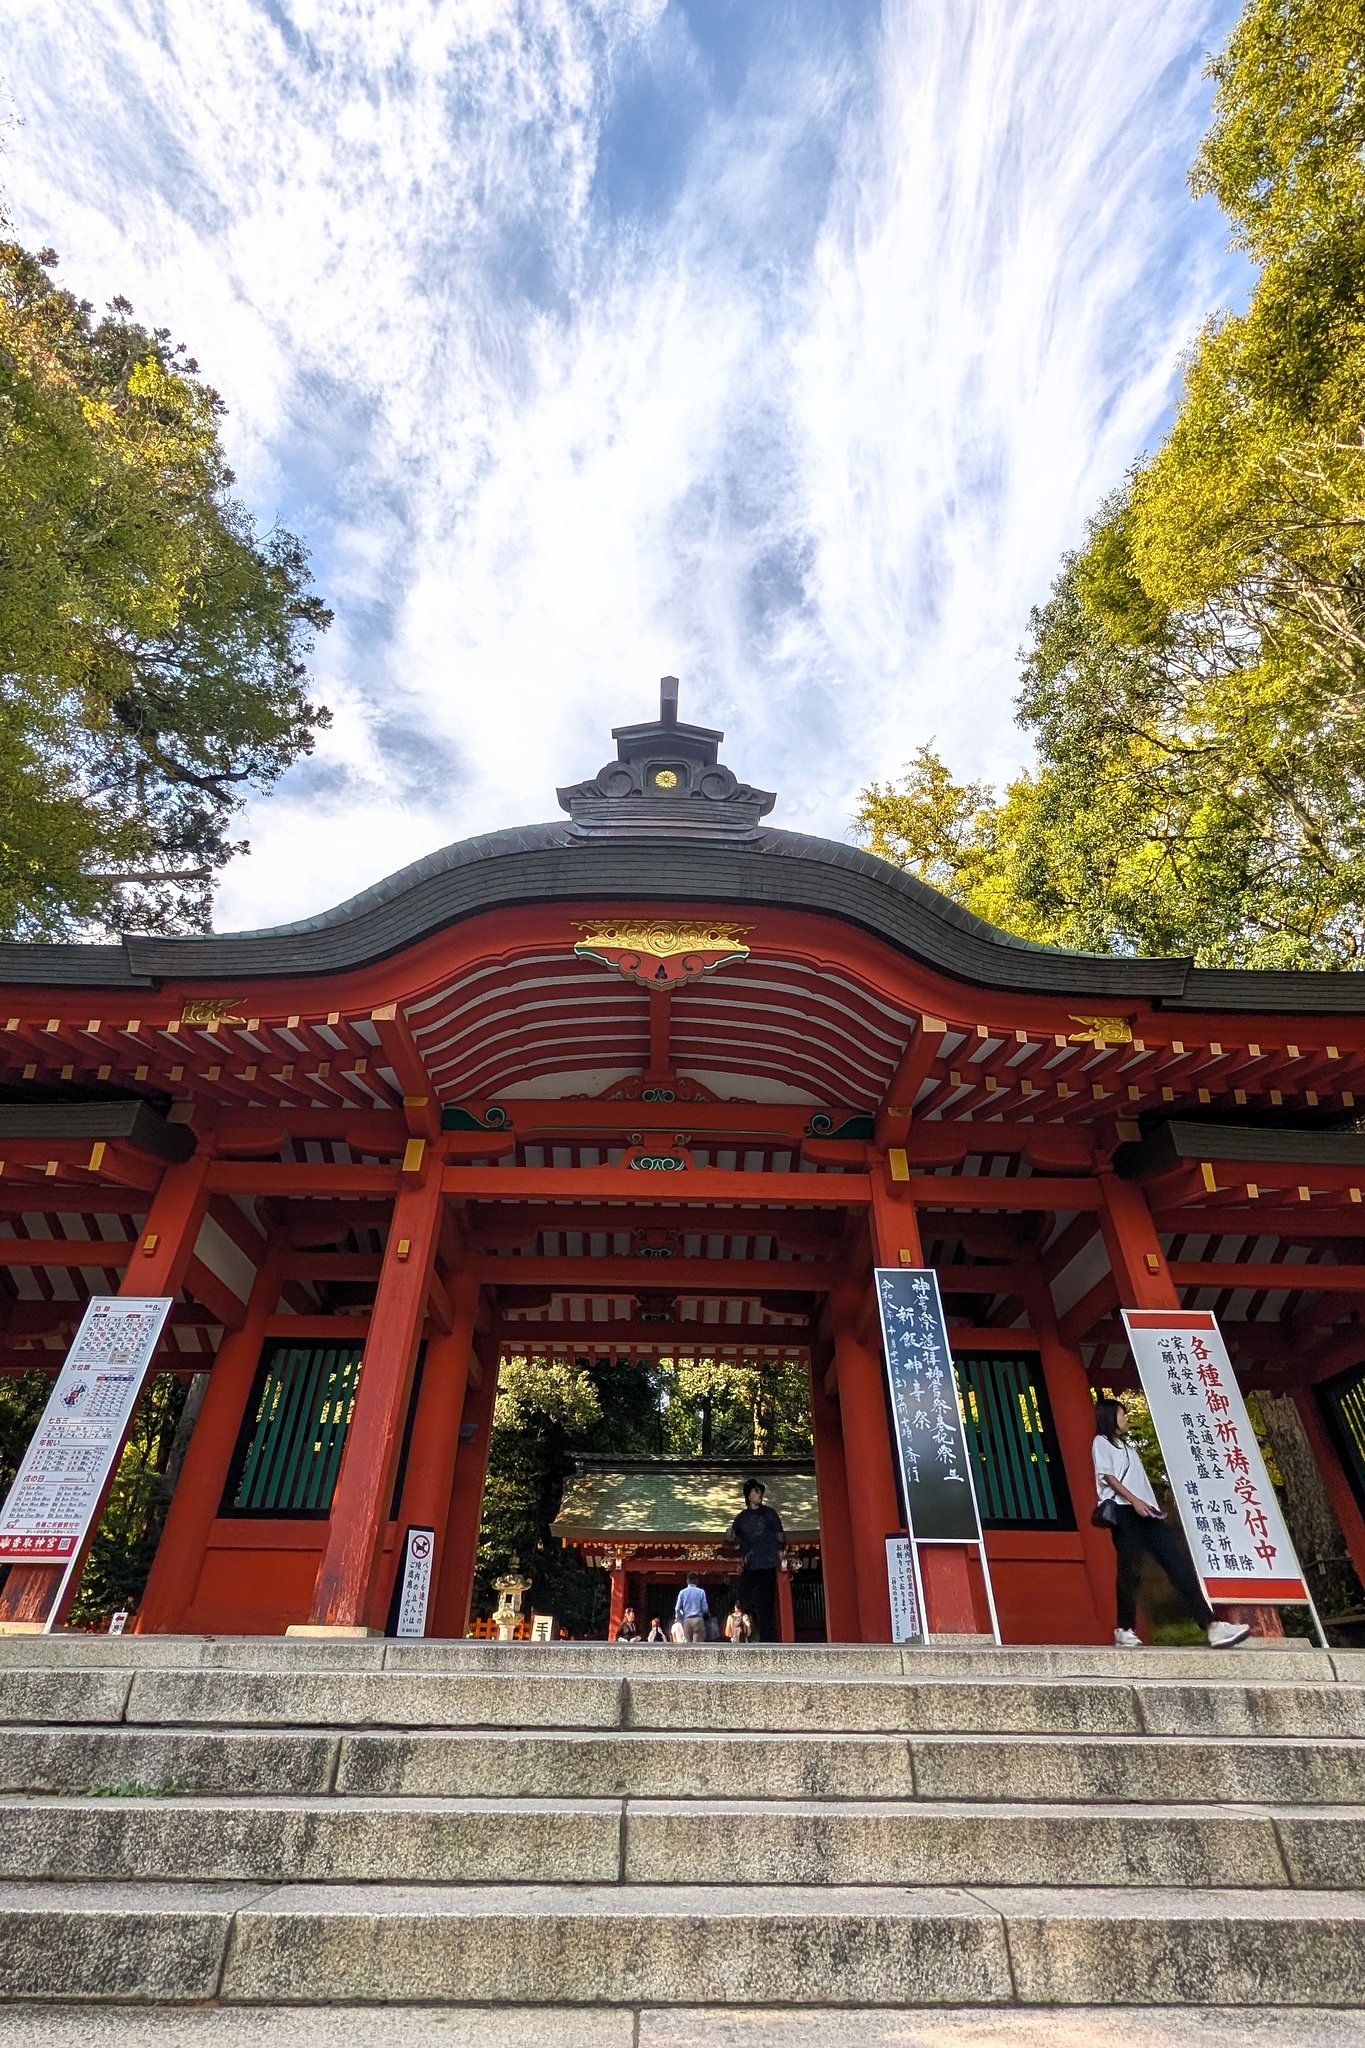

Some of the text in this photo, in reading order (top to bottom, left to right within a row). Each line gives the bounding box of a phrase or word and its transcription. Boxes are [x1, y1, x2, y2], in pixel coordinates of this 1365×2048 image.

[1157, 1338, 1185, 1396] 心願成就
[1170, 1335, 1198, 1396] 家内安全
[1180, 1411, 1211, 1479] 商売繁盛
[1190, 1335, 1277, 1571] 各種御祈祷受付中
[1195, 1412, 1225, 1480] 交通安全
[22, 1475, 45, 1483] 戌の日
[12, 1536, 58, 1549] 香取神宮
[1184, 1480, 1220, 1571] 諸祈願受付
[1207, 1499, 1240, 1571] 必勝祈願
[402, 1561, 416, 1624] ご遠慮ください
[408, 1561, 422, 1624] 境内の立入は
[415, 1562, 429, 1625] ペットを連れての
[896, 1544, 908, 1615] お断りしております
